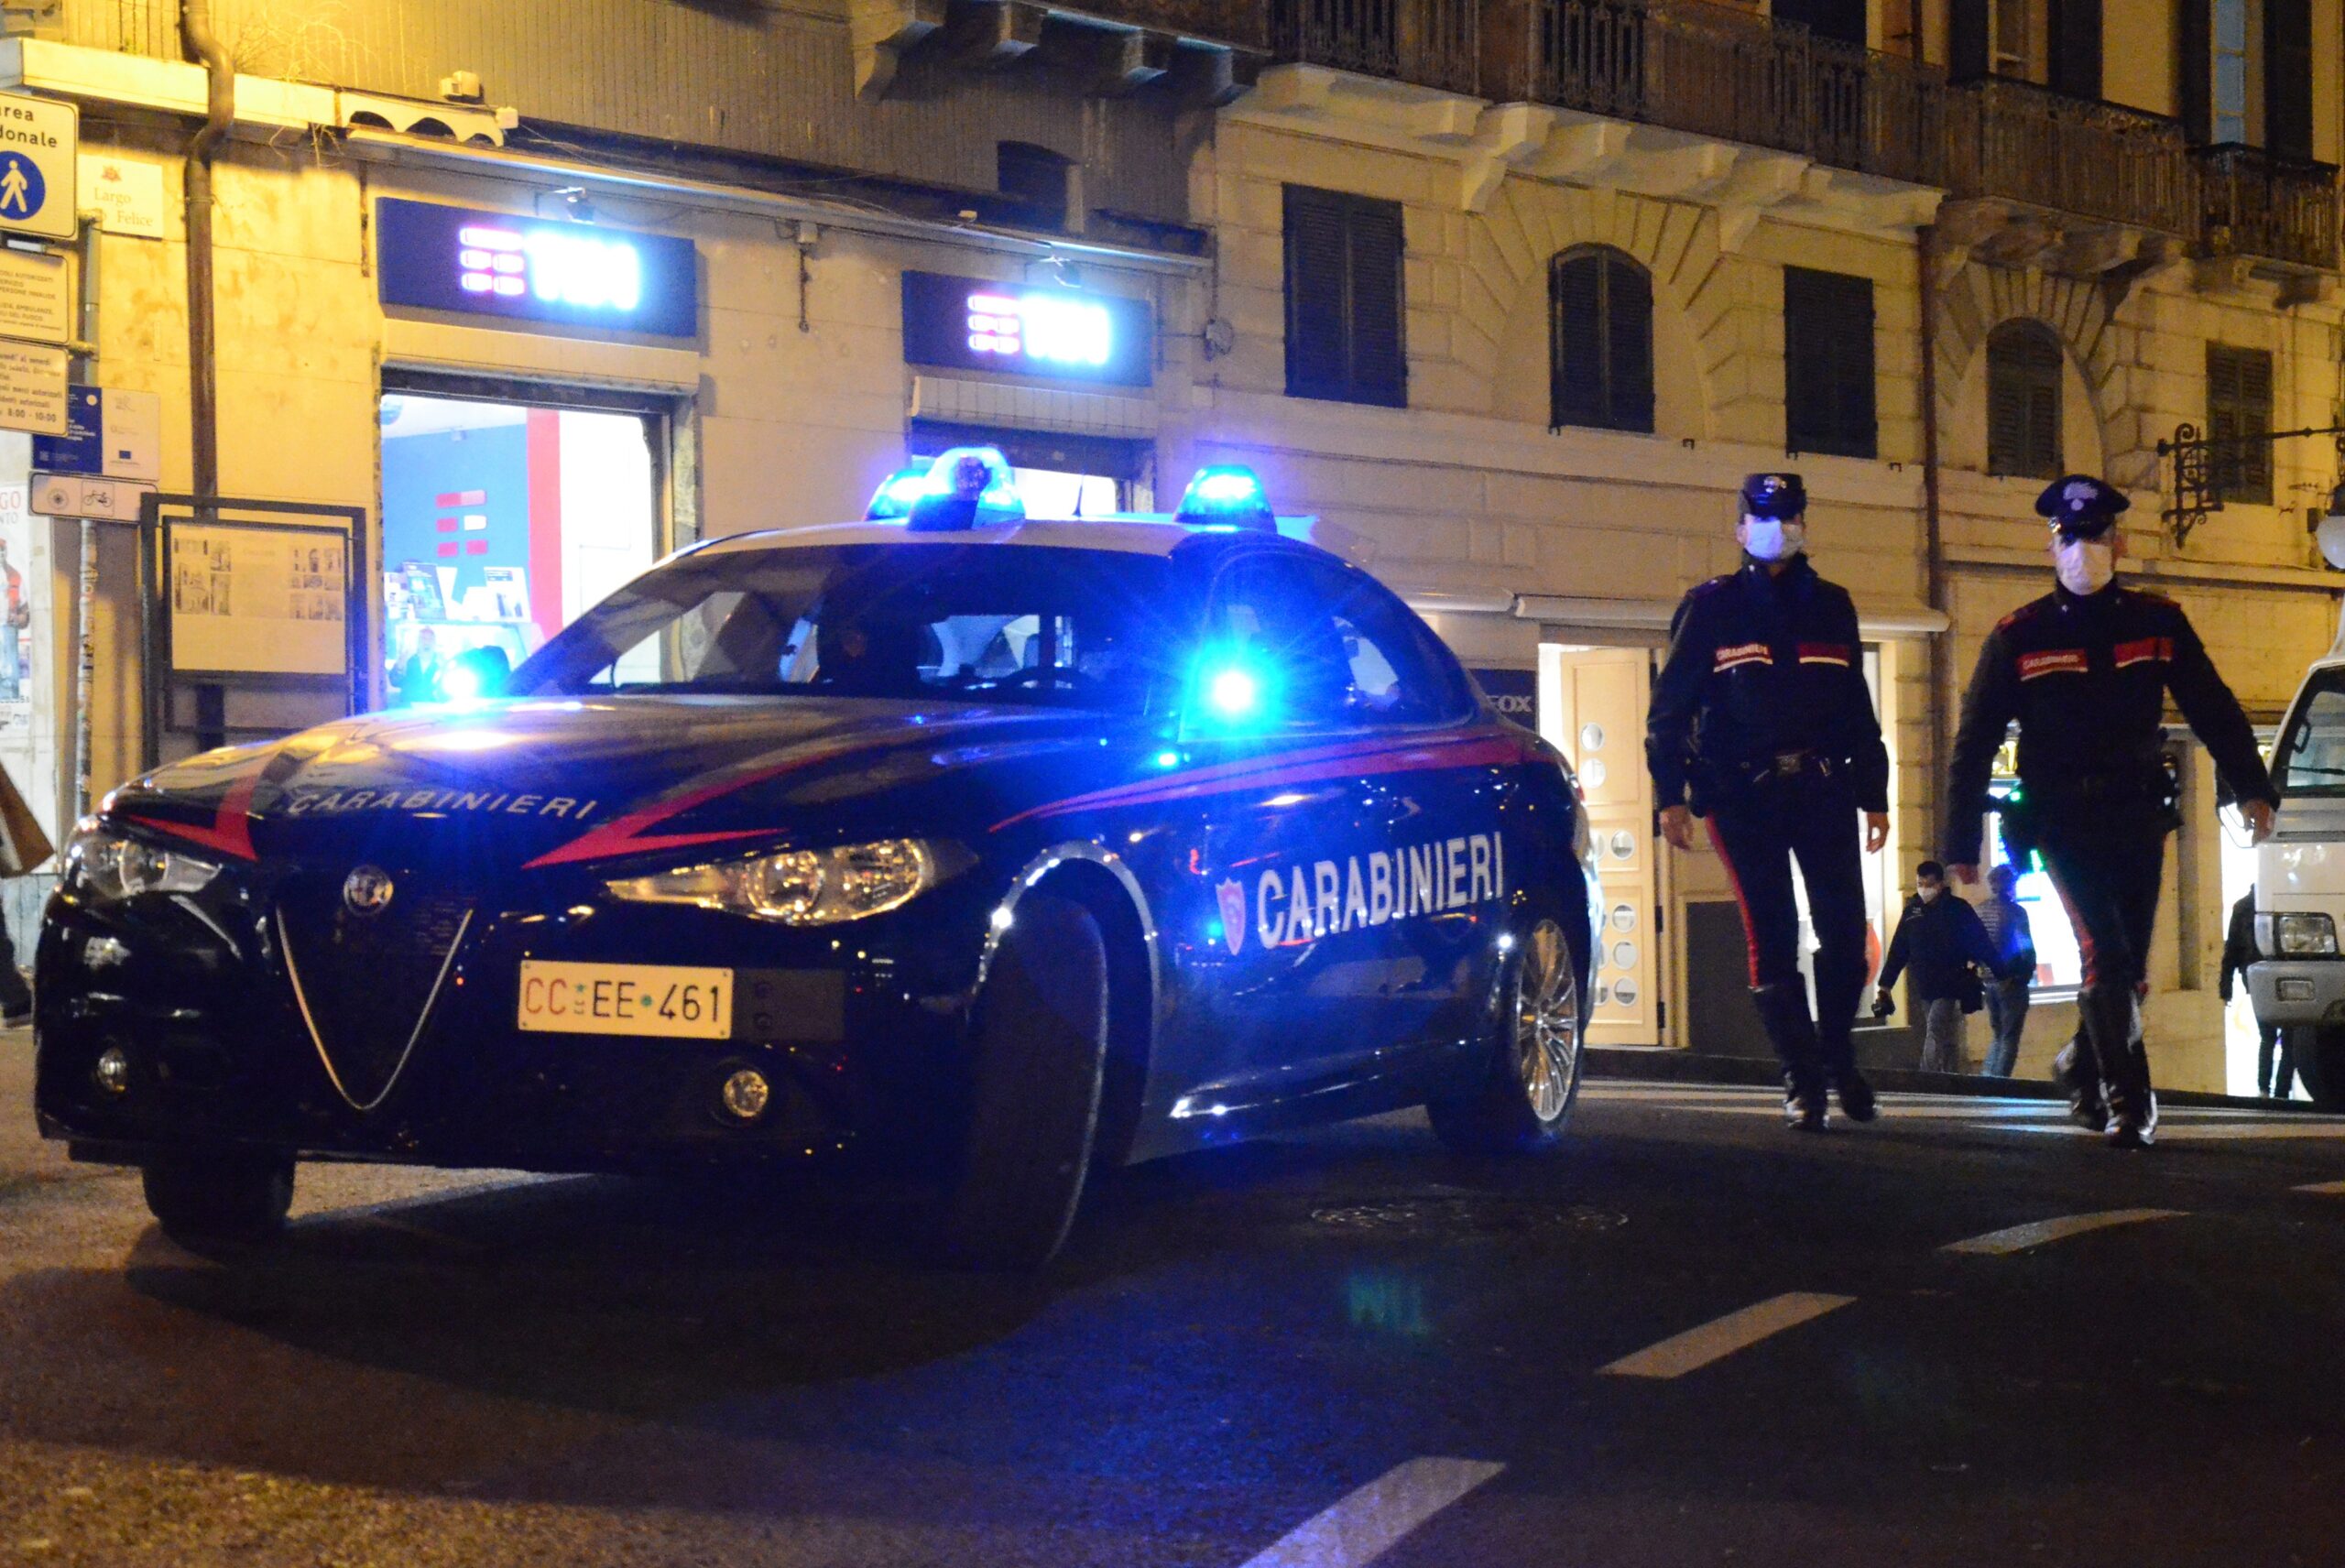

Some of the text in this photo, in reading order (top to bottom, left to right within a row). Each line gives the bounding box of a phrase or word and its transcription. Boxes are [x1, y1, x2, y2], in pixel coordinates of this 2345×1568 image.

[0, 105, 34, 122] rea
[94, 186, 132, 207] Largo
[116, 210, 154, 227] Felice
[288, 790, 598, 820] CARABINIERI
[1257, 831, 1504, 949] CARABINIERI
[524, 977, 567, 1015] CC
[592, 980, 636, 1018] EE
[658, 983, 720, 1023] 461
